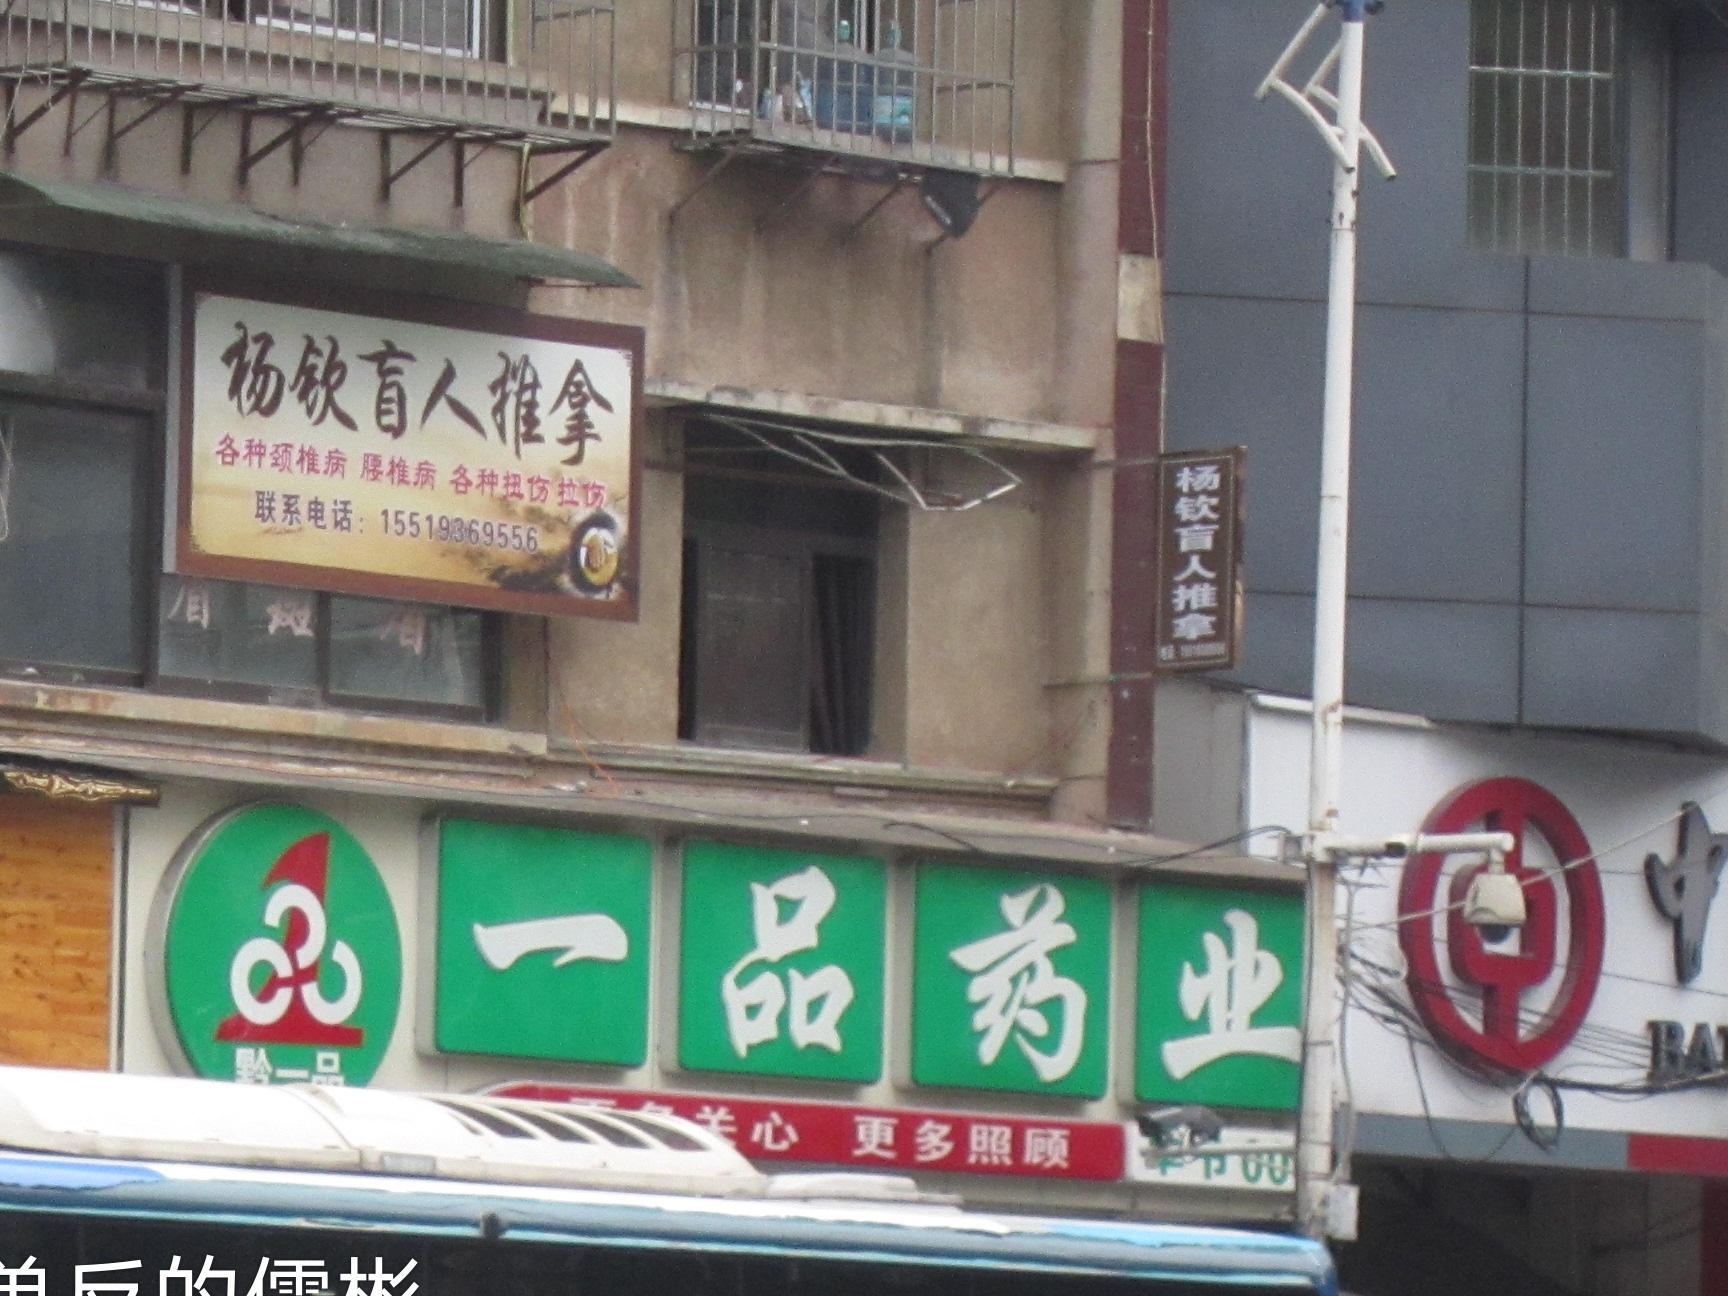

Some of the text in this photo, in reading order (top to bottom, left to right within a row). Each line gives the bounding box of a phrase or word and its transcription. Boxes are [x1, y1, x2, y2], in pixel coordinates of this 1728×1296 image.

[220, 320, 614, 467] 杨钦盲人推拿
[215, 432, 348, 480] 各种颈椎病
[360, 451, 437, 491] 腰椎病
[472, 864, 1303, 1083] 一品药业
[1646, 1018, 1728, 1088] BA
[853, 1114, 1070, 1169] 更多照顾
